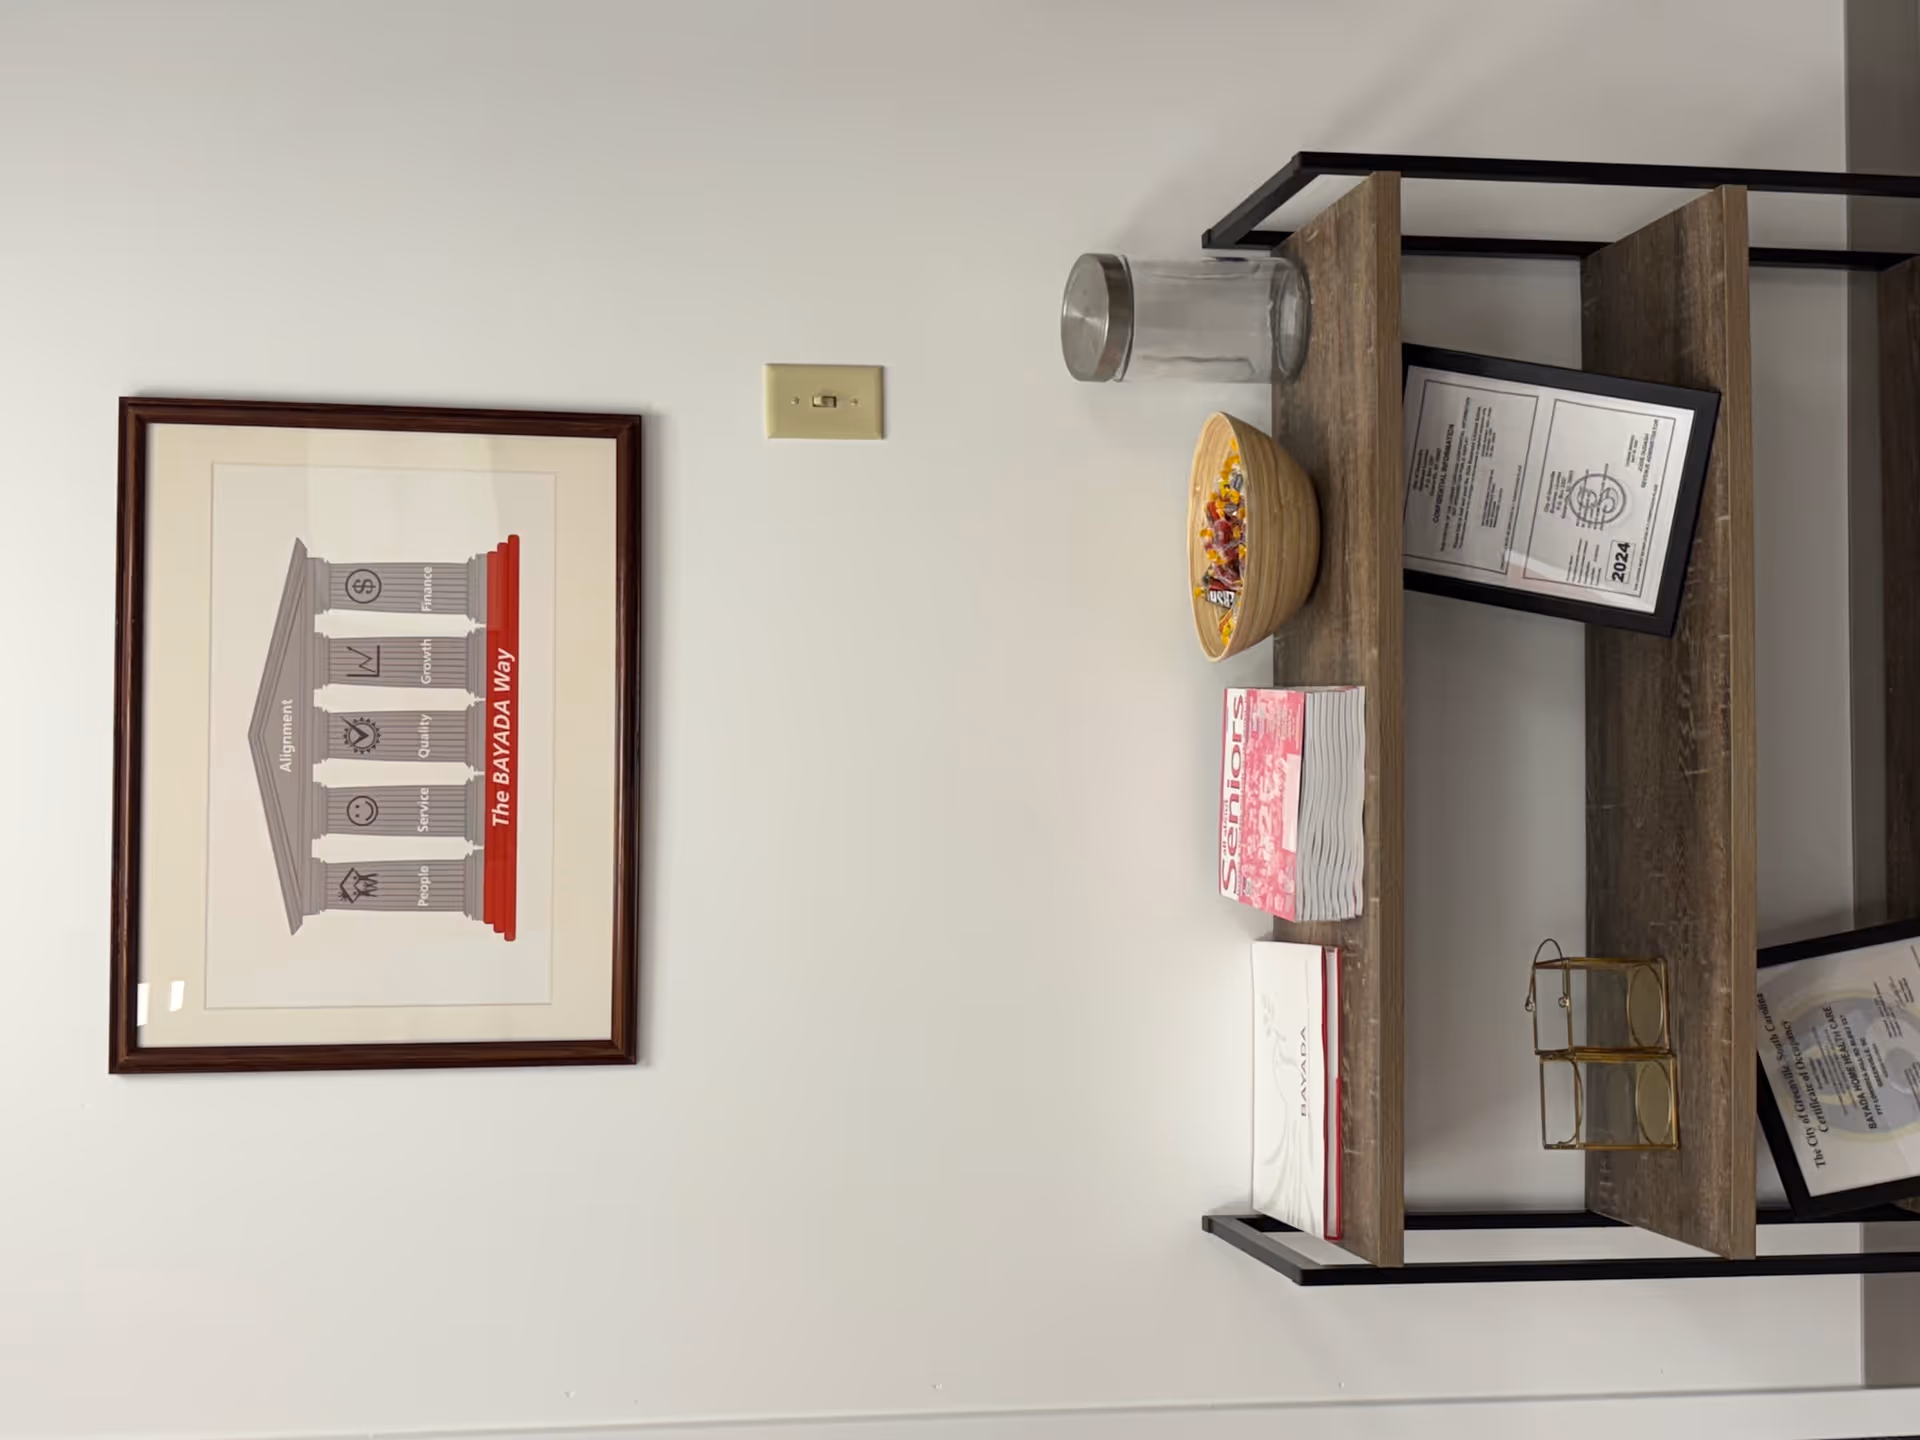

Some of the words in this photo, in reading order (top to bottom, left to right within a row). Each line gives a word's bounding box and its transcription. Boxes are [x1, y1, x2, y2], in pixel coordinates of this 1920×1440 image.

[1432, 473, 1448, 524] CONFIDENTIAL
[1440, 424, 1455, 472] INFORMATION
[1612, 542, 1630, 583] 2024
[421, 566, 433, 612] Finance
[420, 638, 432, 684] Growth
[493, 648, 516, 692] Way
[280, 698, 296, 772] Alignment
[418, 714, 432, 758] Quality
[492, 700, 511, 785] BAYADA
[417, 787, 430, 832] Service
[491, 790, 510, 827] The
[1222, 694, 1244, 894] Seniors
[418, 865, 432, 907] People
[1756, 992, 1776, 1032] Carolina
[1822, 1006, 1840, 1029] CARE
[1772, 1034, 1786, 1060] South
[1782, 1020, 1804, 1070] Occupancy
[1834, 1030, 1853, 1064] HEALTH
[1800, 1072, 1811, 1081] of
[1846, 1066, 1864, 1091] HOME
[1799, 1114, 1812, 1124] of
[1806, 1083, 1829, 1133] Certificate
[1858, 1092, 1878, 1129] BAYADA
[1805, 1126, 1821, 1147] City
[1812, 1148, 1827, 1168] The
